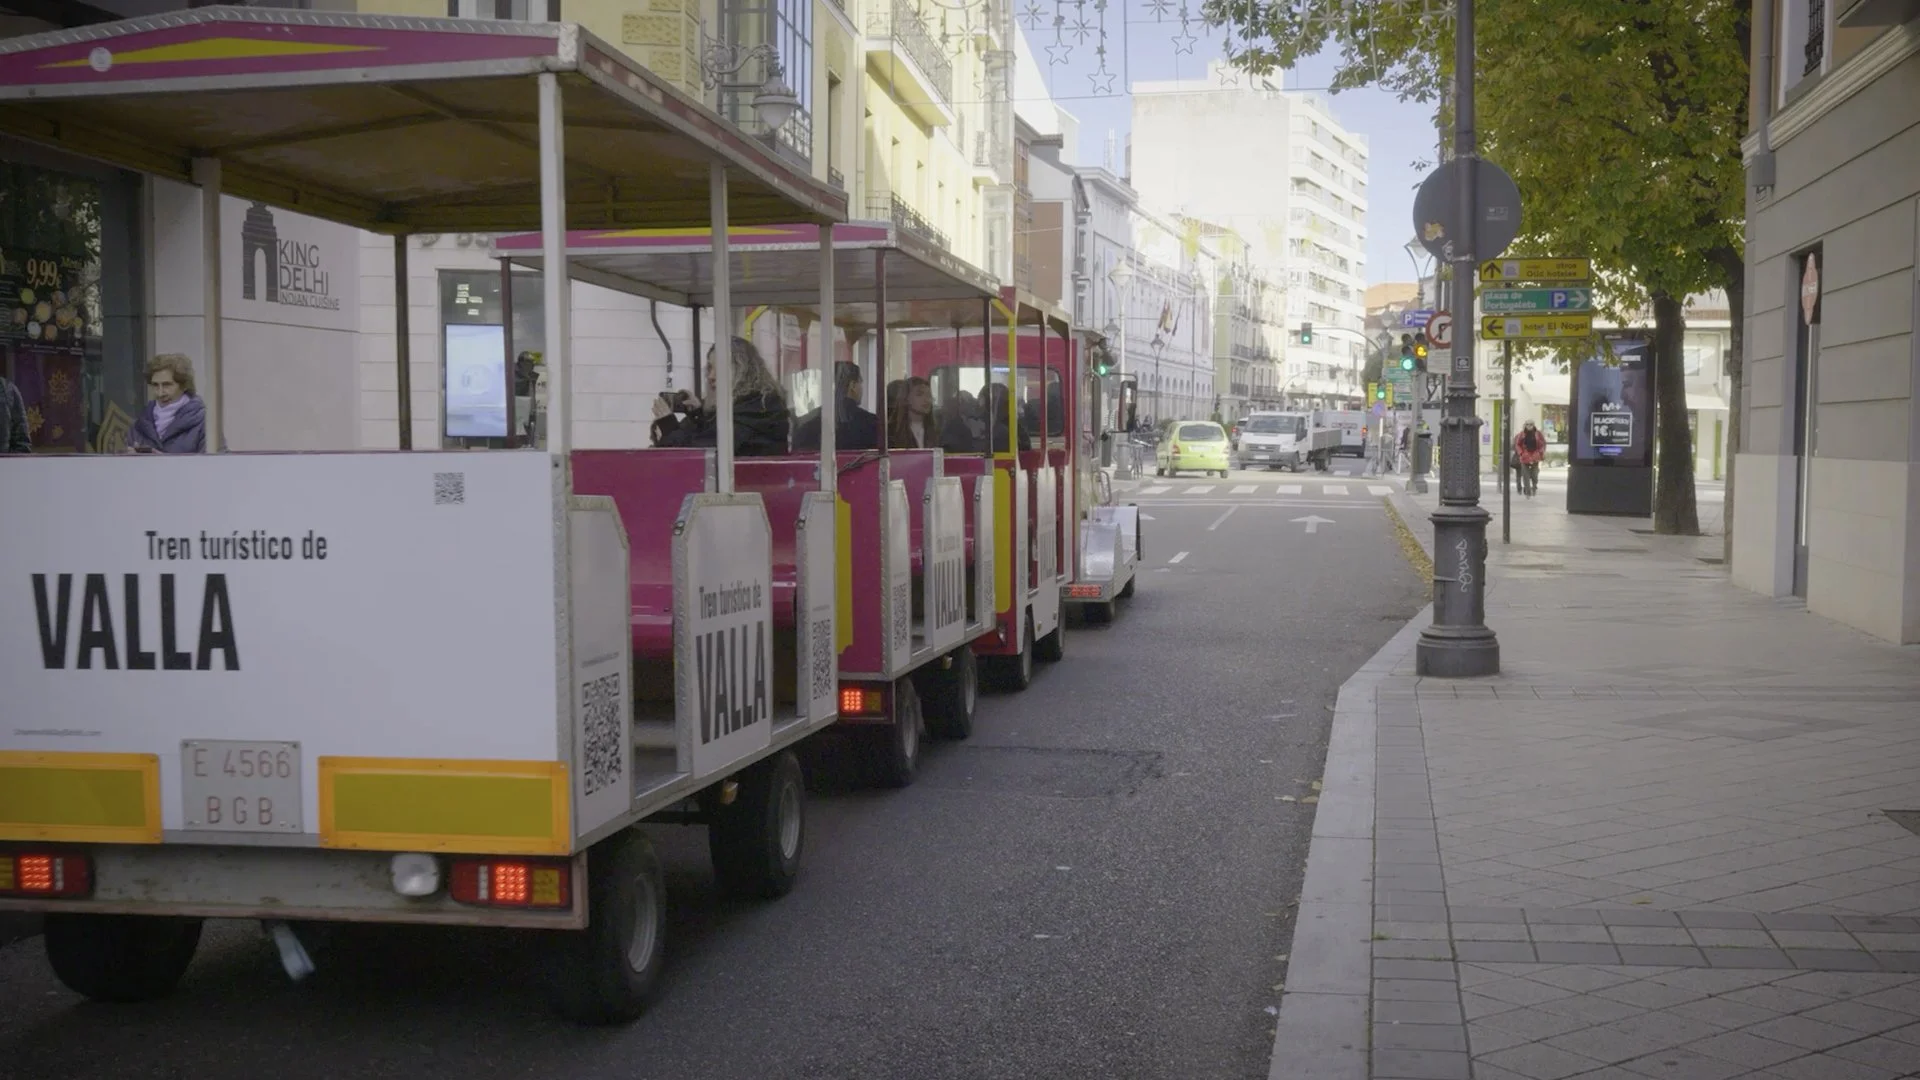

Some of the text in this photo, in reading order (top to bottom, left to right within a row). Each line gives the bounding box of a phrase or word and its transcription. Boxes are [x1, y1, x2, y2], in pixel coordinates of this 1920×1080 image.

[278, 239, 319, 268] KING
[279, 266, 329, 295] DELHI
[281, 292, 340, 308] INDIAN CUISINE
[1484, 292, 1523, 301] plaza de
[1484, 301, 1537, 311] Portugalete
[1553, 292, 1566, 308] P
[1547, 322, 1557, 330] El
[1561, 321, 1588, 331] Nogal
[1594, 425, 1608, 437] 1€
[145, 530, 328, 561] Tren turístico de
[699, 578, 762, 620] Tren turístico de
[934, 558, 964, 630] VALLA
[32, 573, 240, 671] VALLA
[695, 620, 767, 745] VALLA
[193, 749, 292, 778] E 4566
